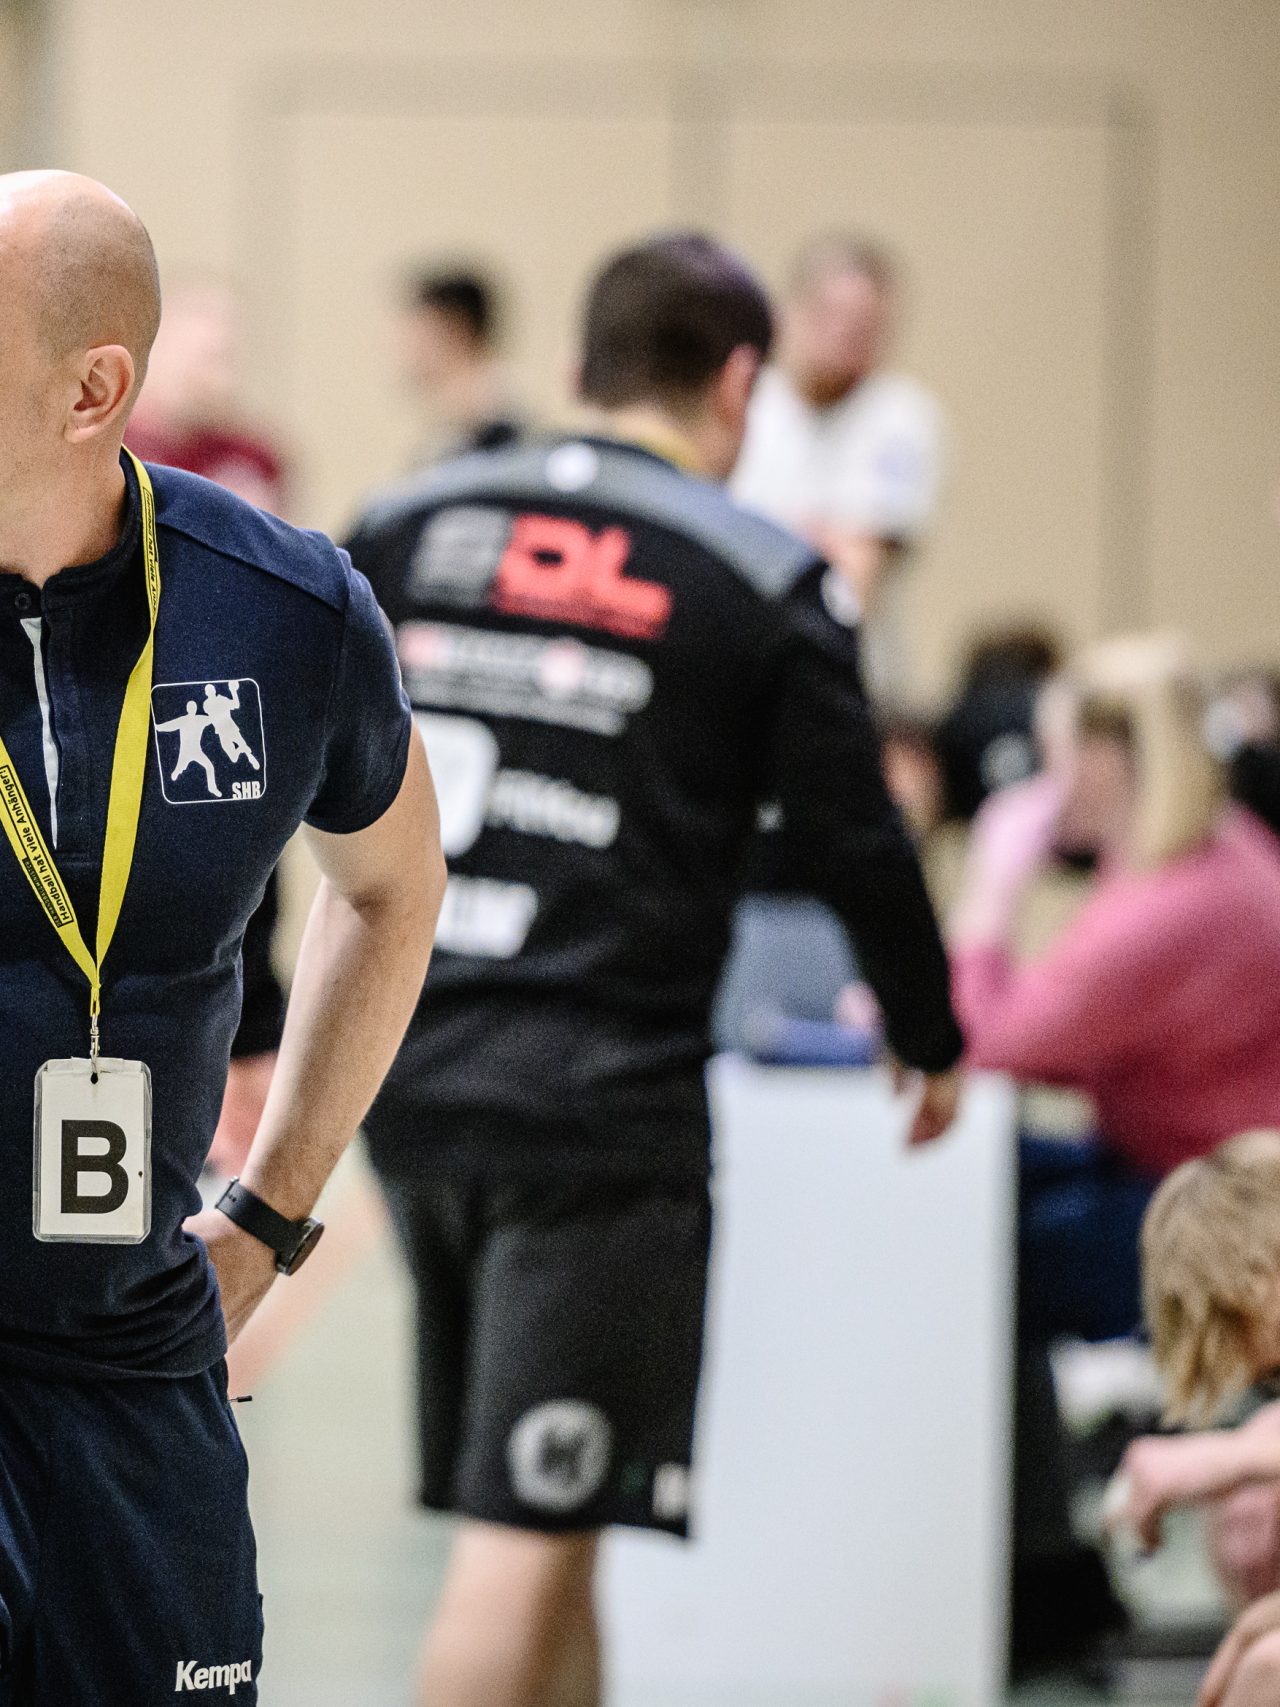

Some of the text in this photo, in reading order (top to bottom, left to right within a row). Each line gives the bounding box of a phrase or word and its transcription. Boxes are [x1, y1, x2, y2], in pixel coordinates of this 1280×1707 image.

[232, 781, 260, 799] SHB
[22, 827, 37, 852] viele
[33, 854, 48, 874] hat
[42, 875, 70, 921] Handball
[61, 1119, 129, 1214] B
[175, 1659, 252, 1695] Kempa
